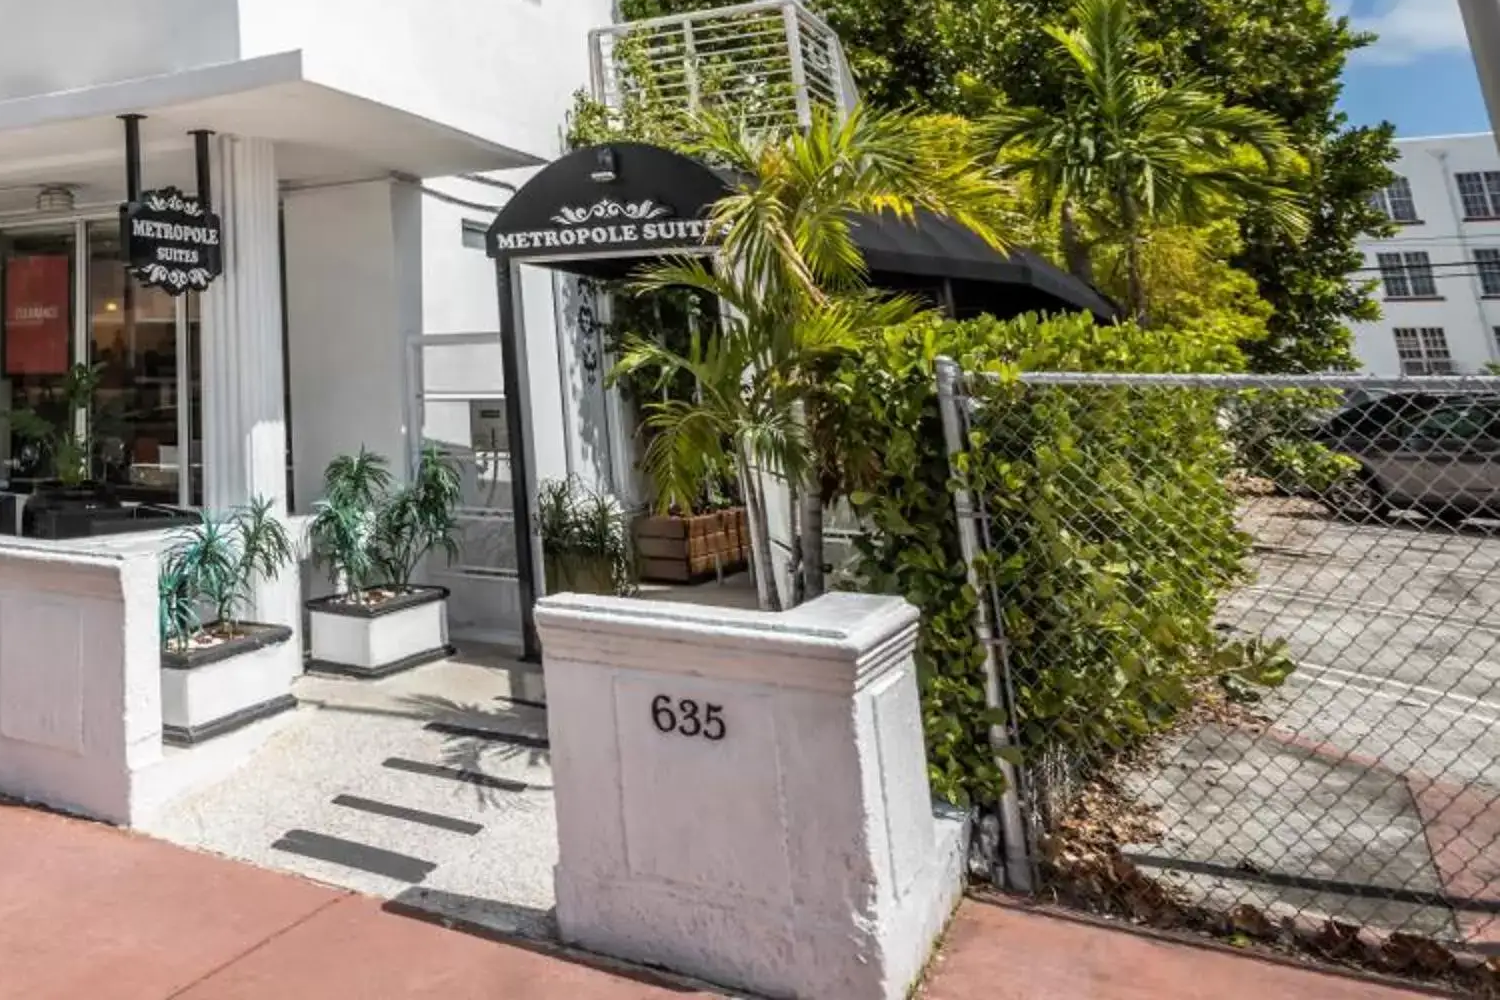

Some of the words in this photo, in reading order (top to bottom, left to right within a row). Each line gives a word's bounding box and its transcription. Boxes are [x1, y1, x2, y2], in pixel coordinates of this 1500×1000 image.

[132, 219, 219, 245] METROPOLE
[496, 224, 639, 249] METROPOLE
[642, 218, 736, 240] SUITS
[156, 246, 199, 263] SUITES
[652, 694, 726, 740] 635
